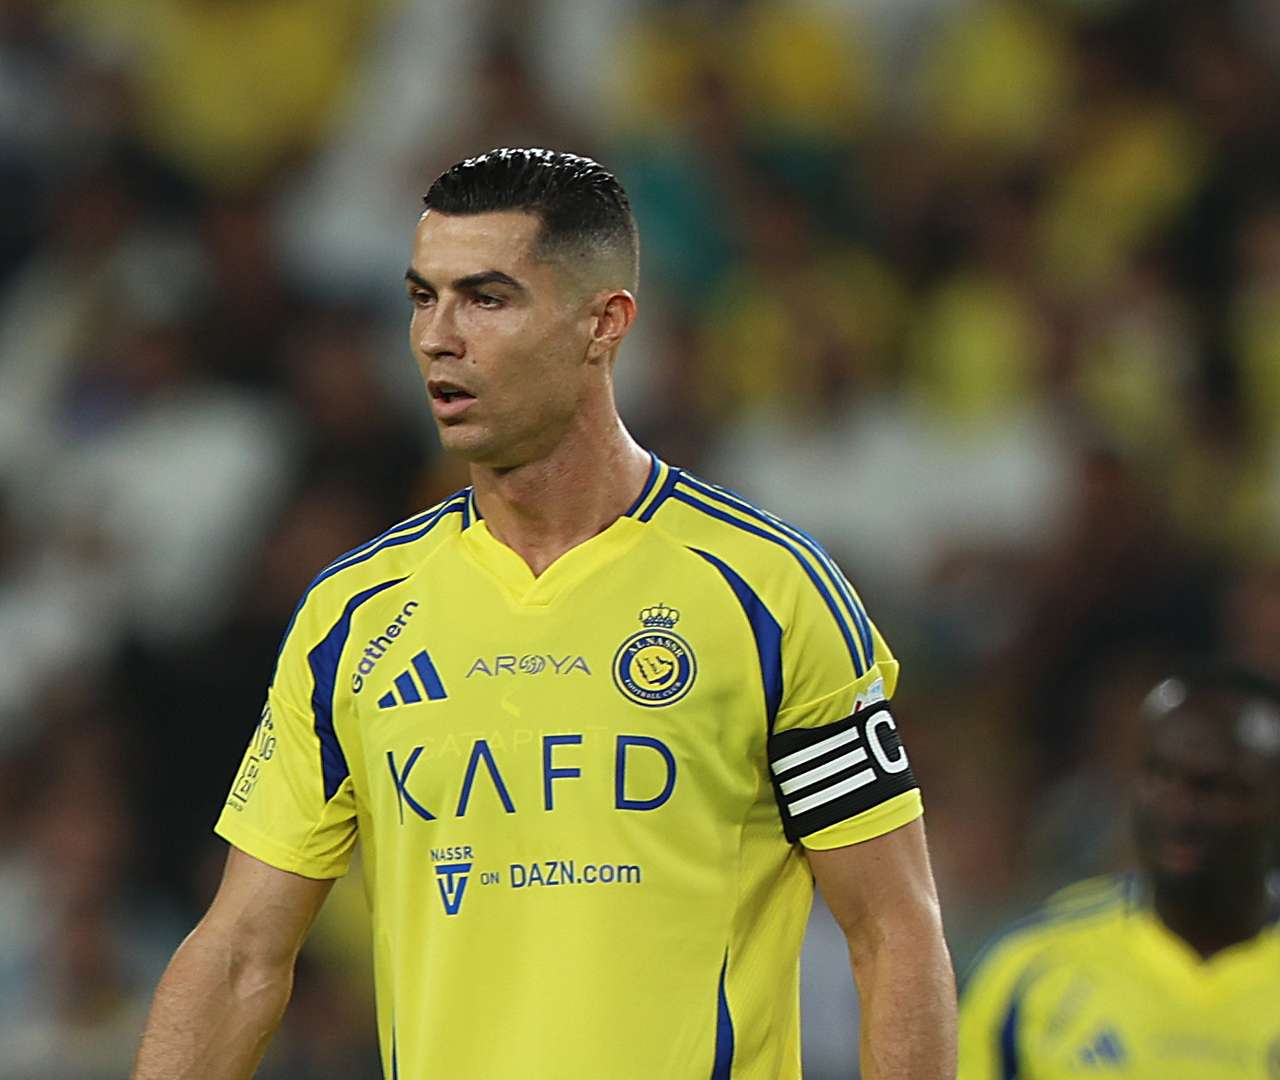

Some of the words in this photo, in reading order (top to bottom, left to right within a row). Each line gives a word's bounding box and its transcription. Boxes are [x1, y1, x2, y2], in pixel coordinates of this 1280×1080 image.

[351, 600, 419, 694] Gathern
[464, 653, 592, 679] AROYA
[865, 710, 909, 774] C
[386, 734, 677, 825] KAFD
[430, 845, 474, 862] NASSR
[480, 871, 500, 886] ON
[509, 860, 641, 889] DAZN.com
